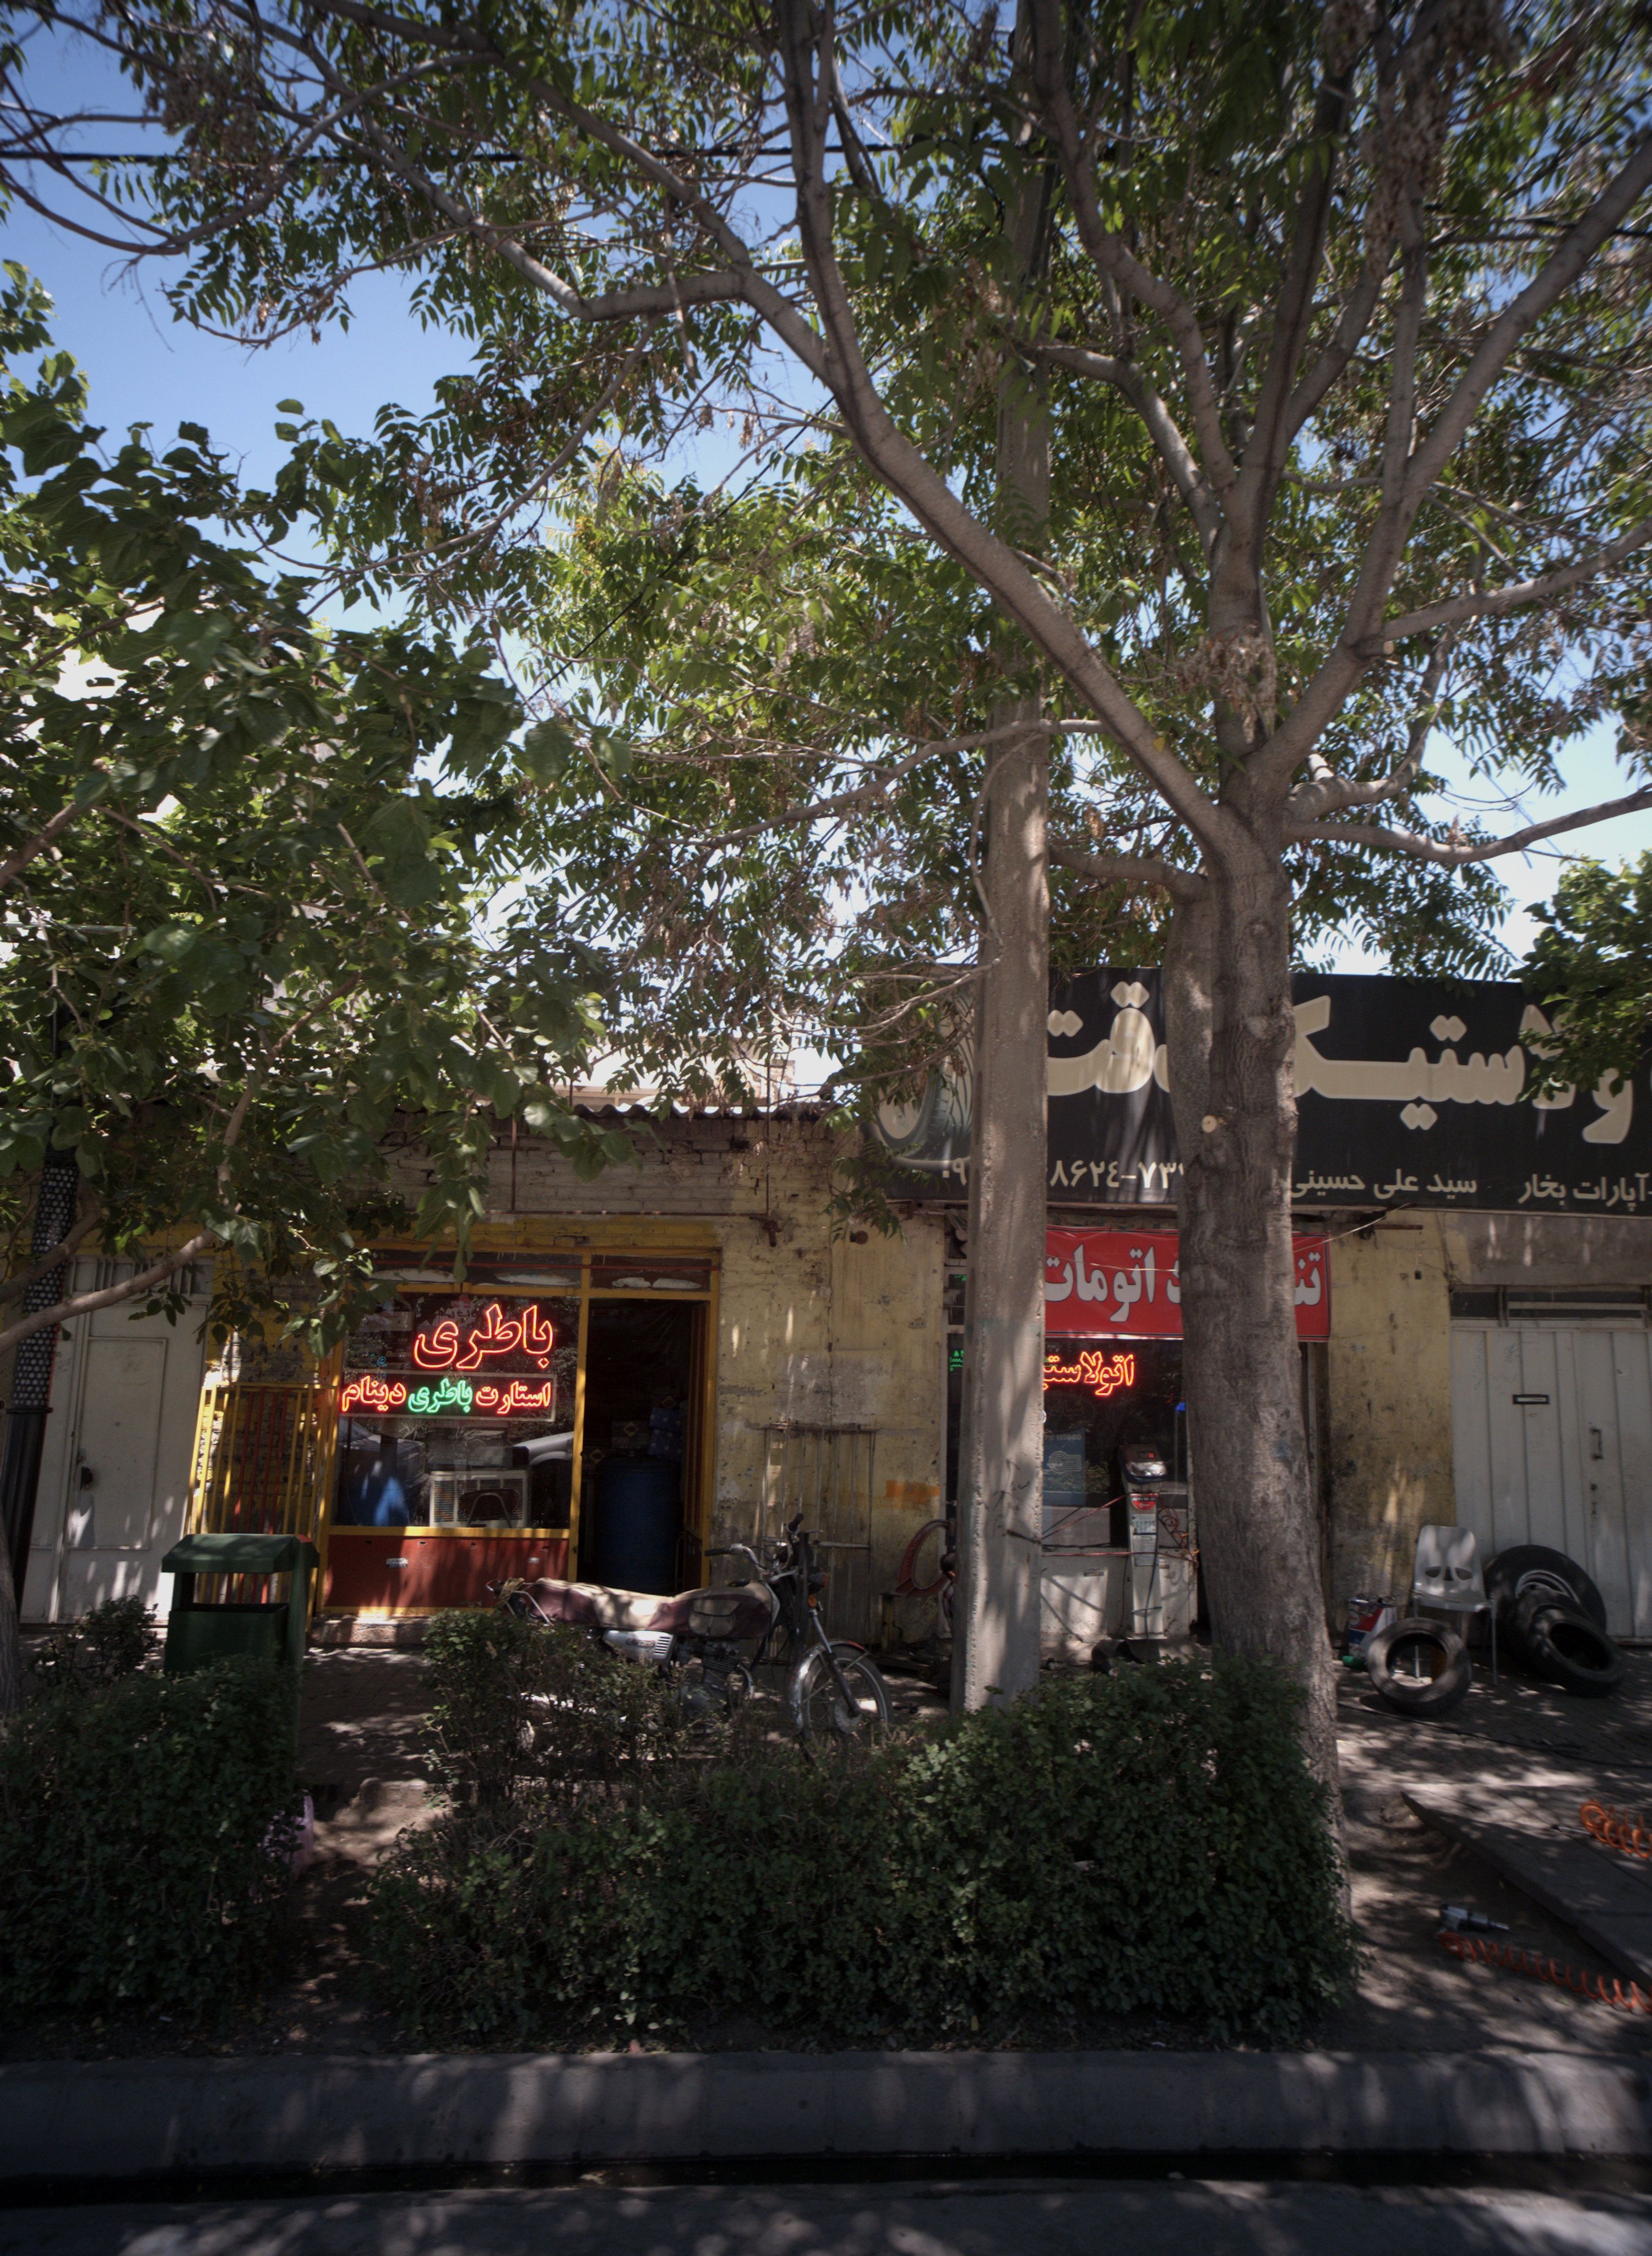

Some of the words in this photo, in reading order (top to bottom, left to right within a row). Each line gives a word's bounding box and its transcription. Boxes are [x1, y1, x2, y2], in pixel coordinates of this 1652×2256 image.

[1291, 1169, 1366, 1198] حسینی
[1373, 1168, 1420, 1200] علی
[1426, 1173, 1478, 1200] سید
[1518, 1174, 1567, 1205] بخار
[414, 1303, 553, 1370] باطری
[342, 1375, 407, 1412] دینام
[407, 1378, 473, 1413] باطری
[475, 1381, 552, 1414] استارت
